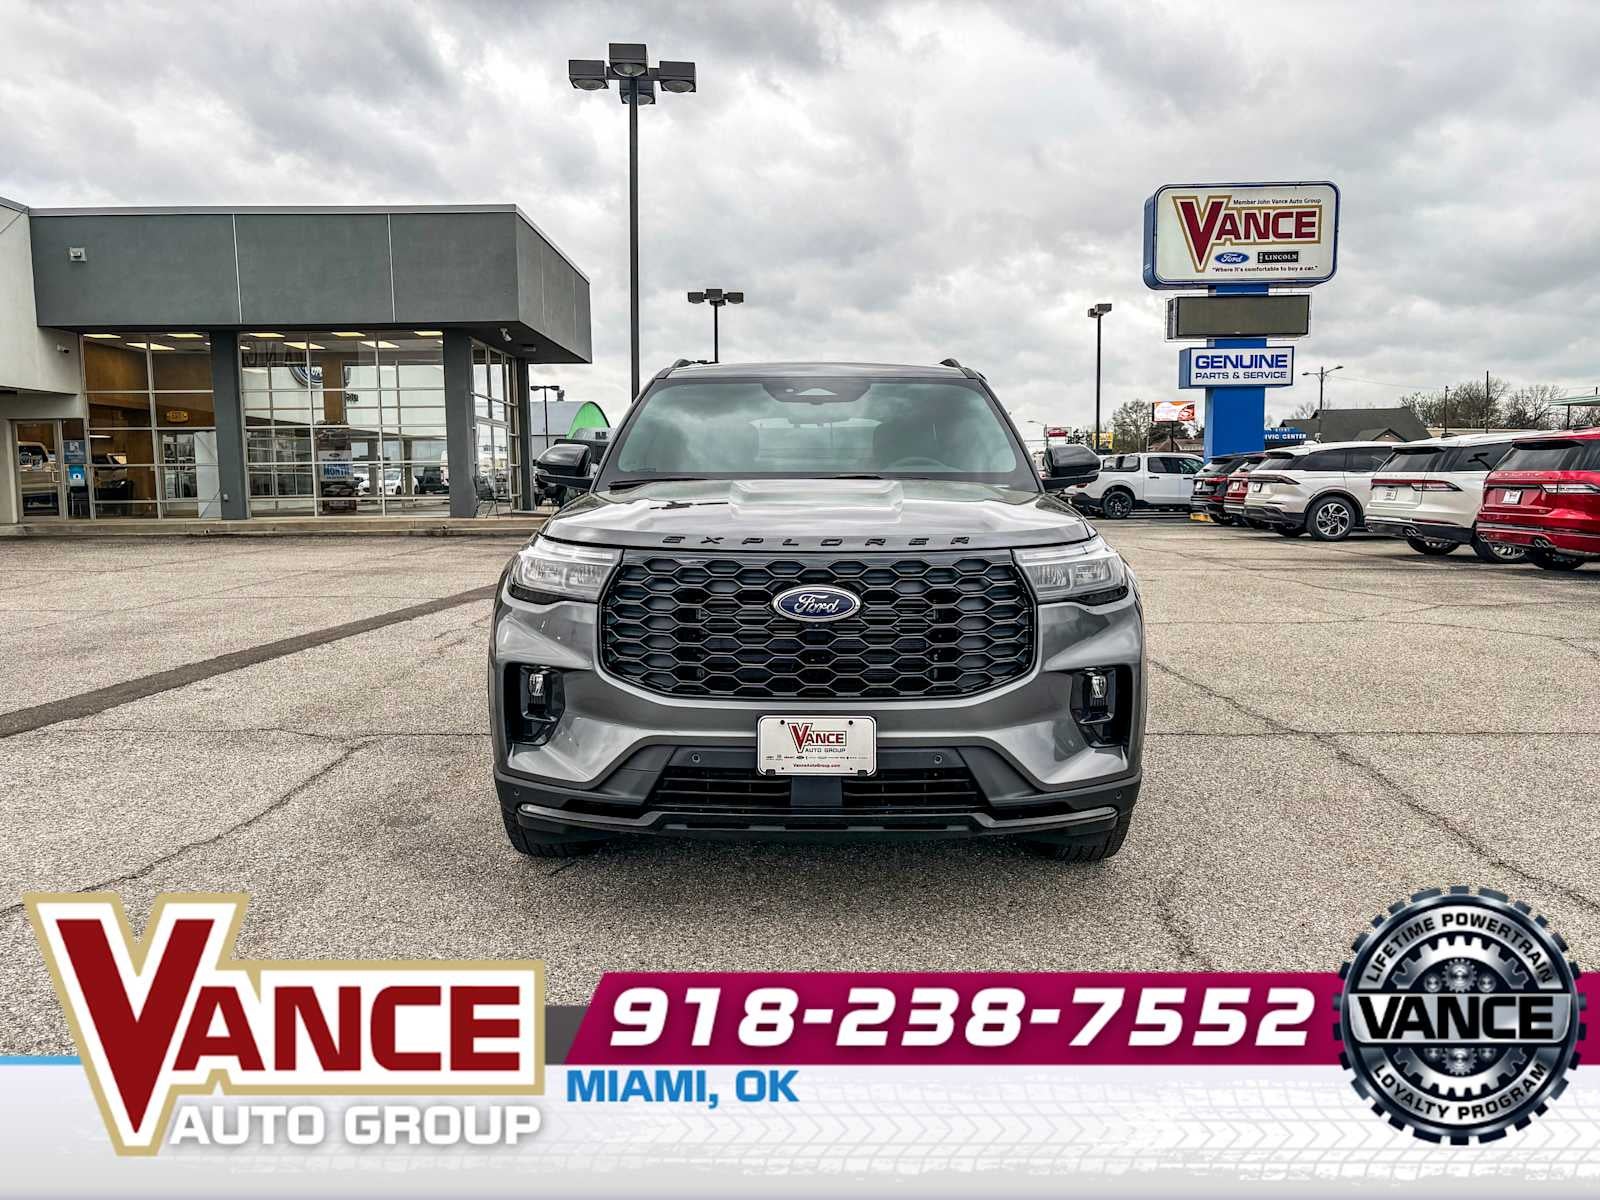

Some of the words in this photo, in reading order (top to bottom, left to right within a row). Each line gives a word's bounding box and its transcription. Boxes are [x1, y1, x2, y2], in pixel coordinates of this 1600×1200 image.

[1180, 201, 1317, 268] VANCE
[1220, 253, 1243, 264] Ford
[1265, 252, 1297, 260] LINCOLN
[1195, 354, 1288, 369] GENUINE
[1232, 371, 1240, 379] &
[1243, 371, 1287, 379] SERVICE
[662, 536, 970, 547] EXPLORER
[794, 593, 840, 614] Ford
[791, 725, 845, 749] VANCE
